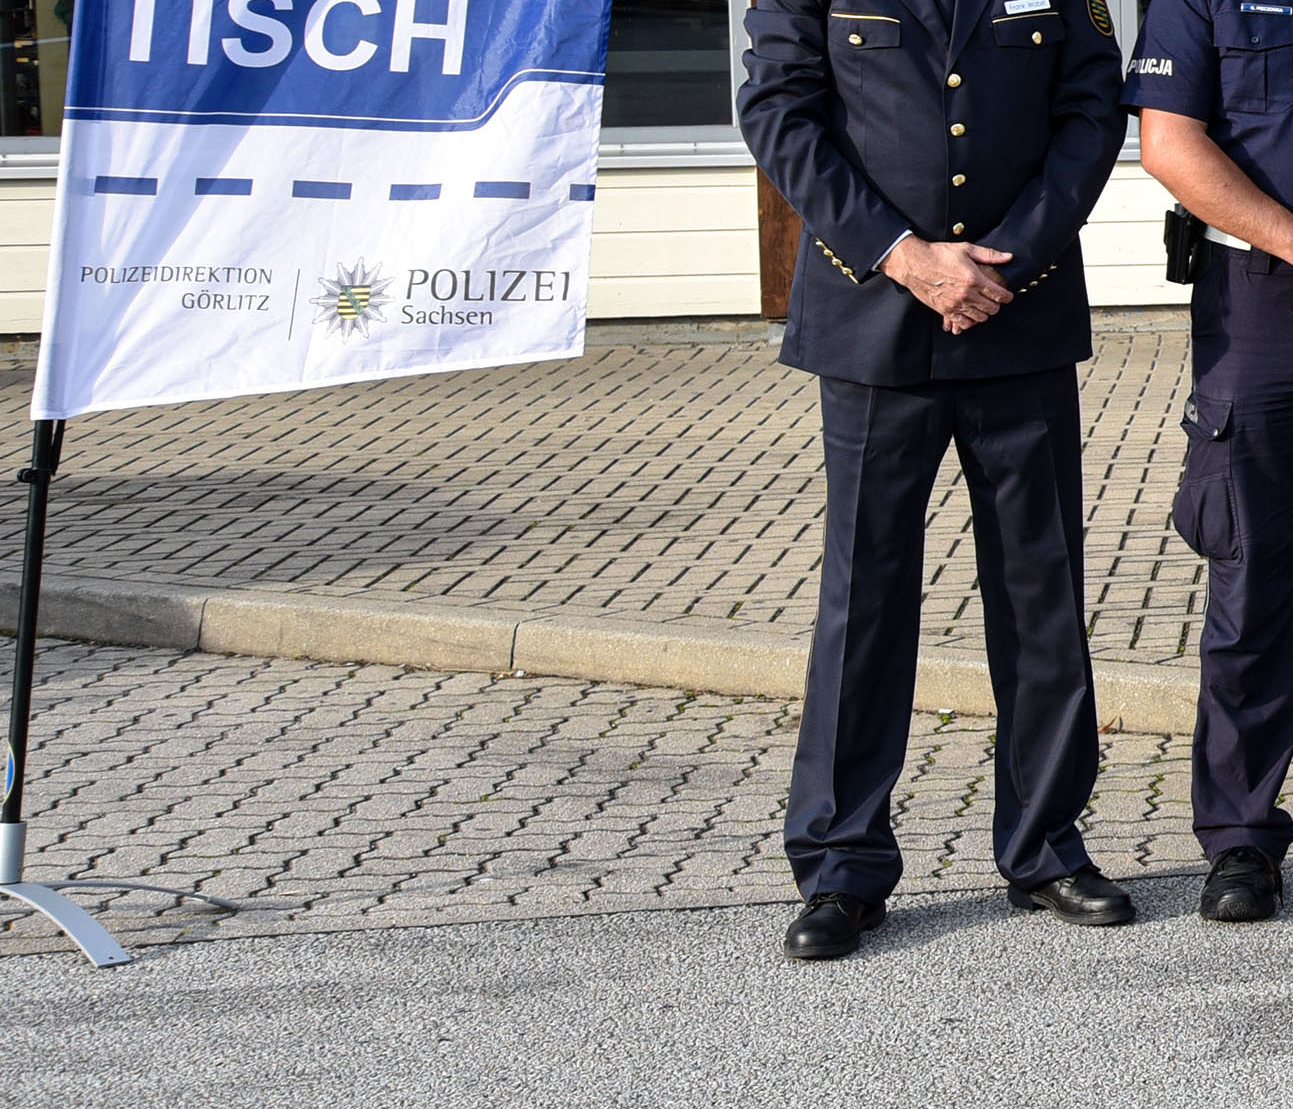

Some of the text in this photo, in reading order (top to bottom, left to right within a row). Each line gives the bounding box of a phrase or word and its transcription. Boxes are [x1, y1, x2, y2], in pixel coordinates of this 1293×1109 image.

[80, 266, 273, 286] POLIZEIDIREKTION
[405, 268, 571, 302] POLIZEI
[181, 289, 269, 311] GÖRLITZ
[401, 305, 493, 325] Sachsen
